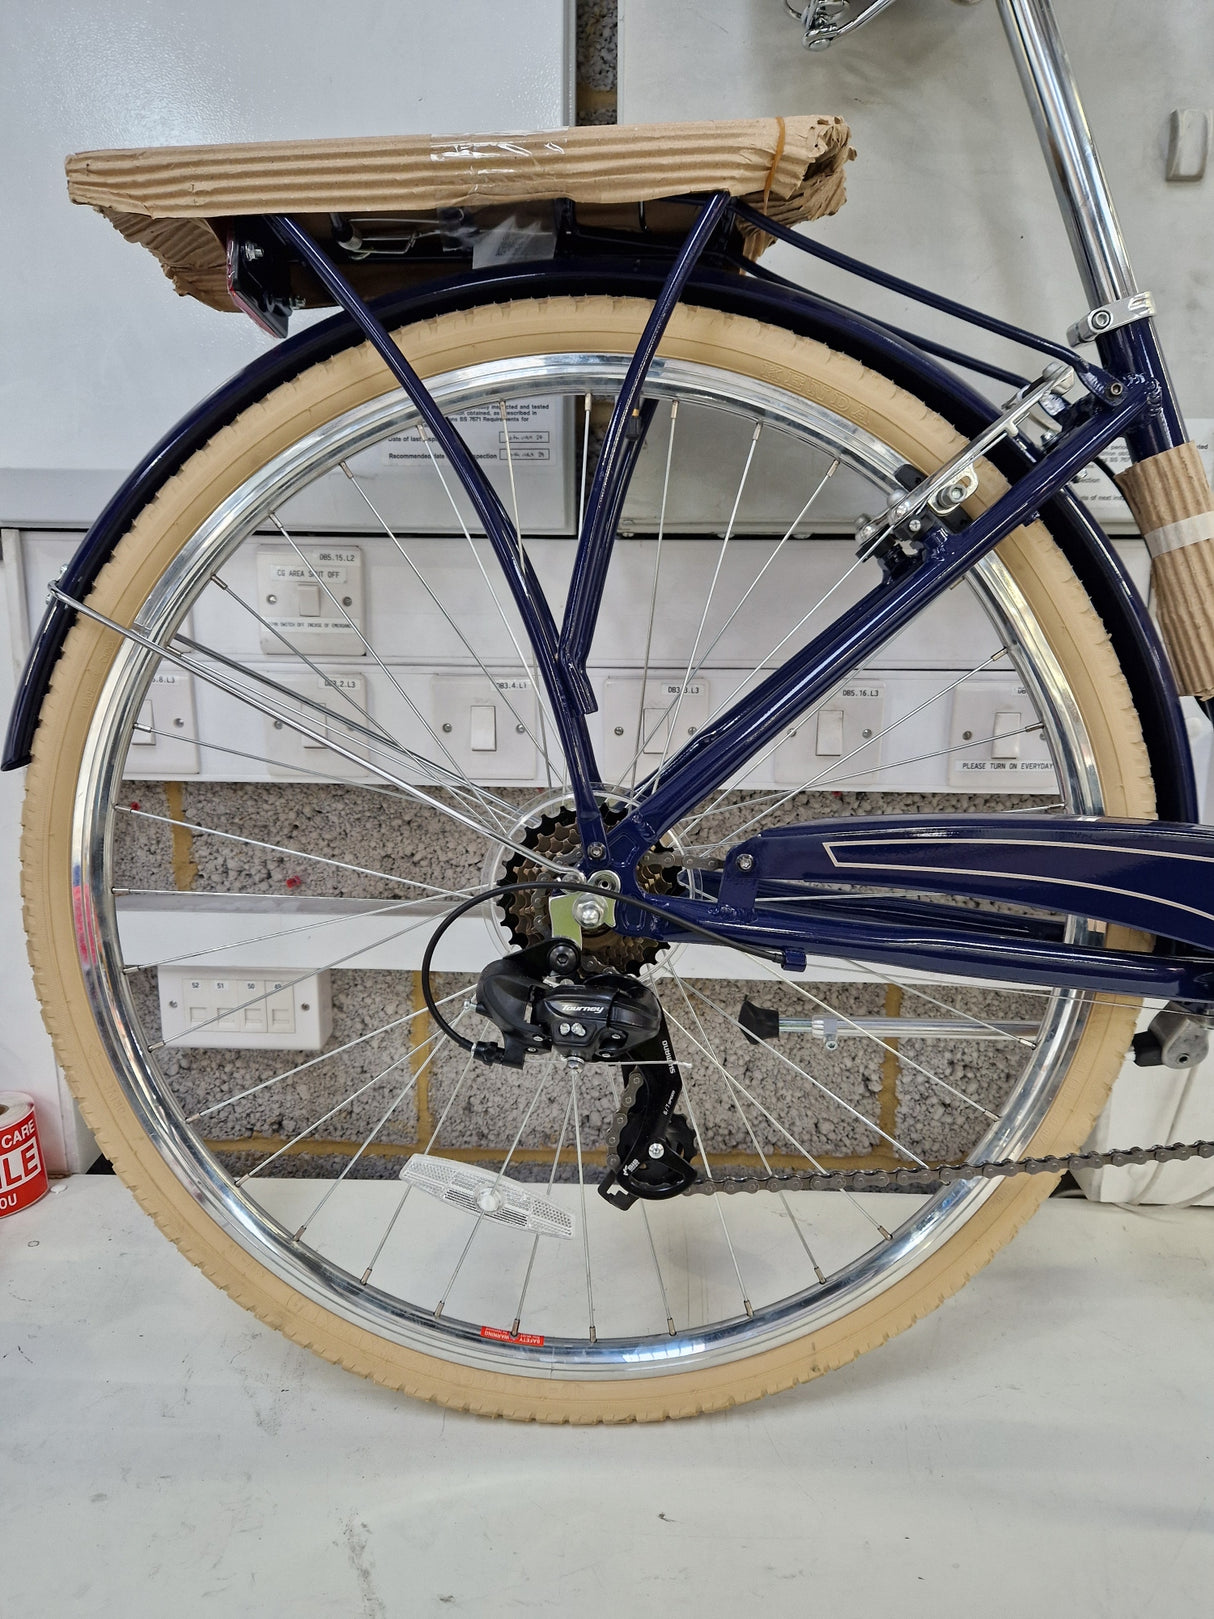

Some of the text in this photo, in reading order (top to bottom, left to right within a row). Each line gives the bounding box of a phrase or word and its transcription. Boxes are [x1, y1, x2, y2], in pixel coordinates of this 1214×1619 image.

[761, 362, 872, 426] KENDA
[319, 553, 355, 562] DB5.15.L2
[289, 570, 304, 578] AREA
[328, 571, 340, 579] OFF
[962, 762, 986, 770] PLEASE
[990, 762, 1006, 770] TURN
[561, 1004, 605, 1014] Tourney
[661, 1039, 677, 1074] SHMANO
[1, 1119, 35, 1148] CARE
[0, 1143, 39, 1191] LE
[485, 1331, 509, 1340] WARNING
